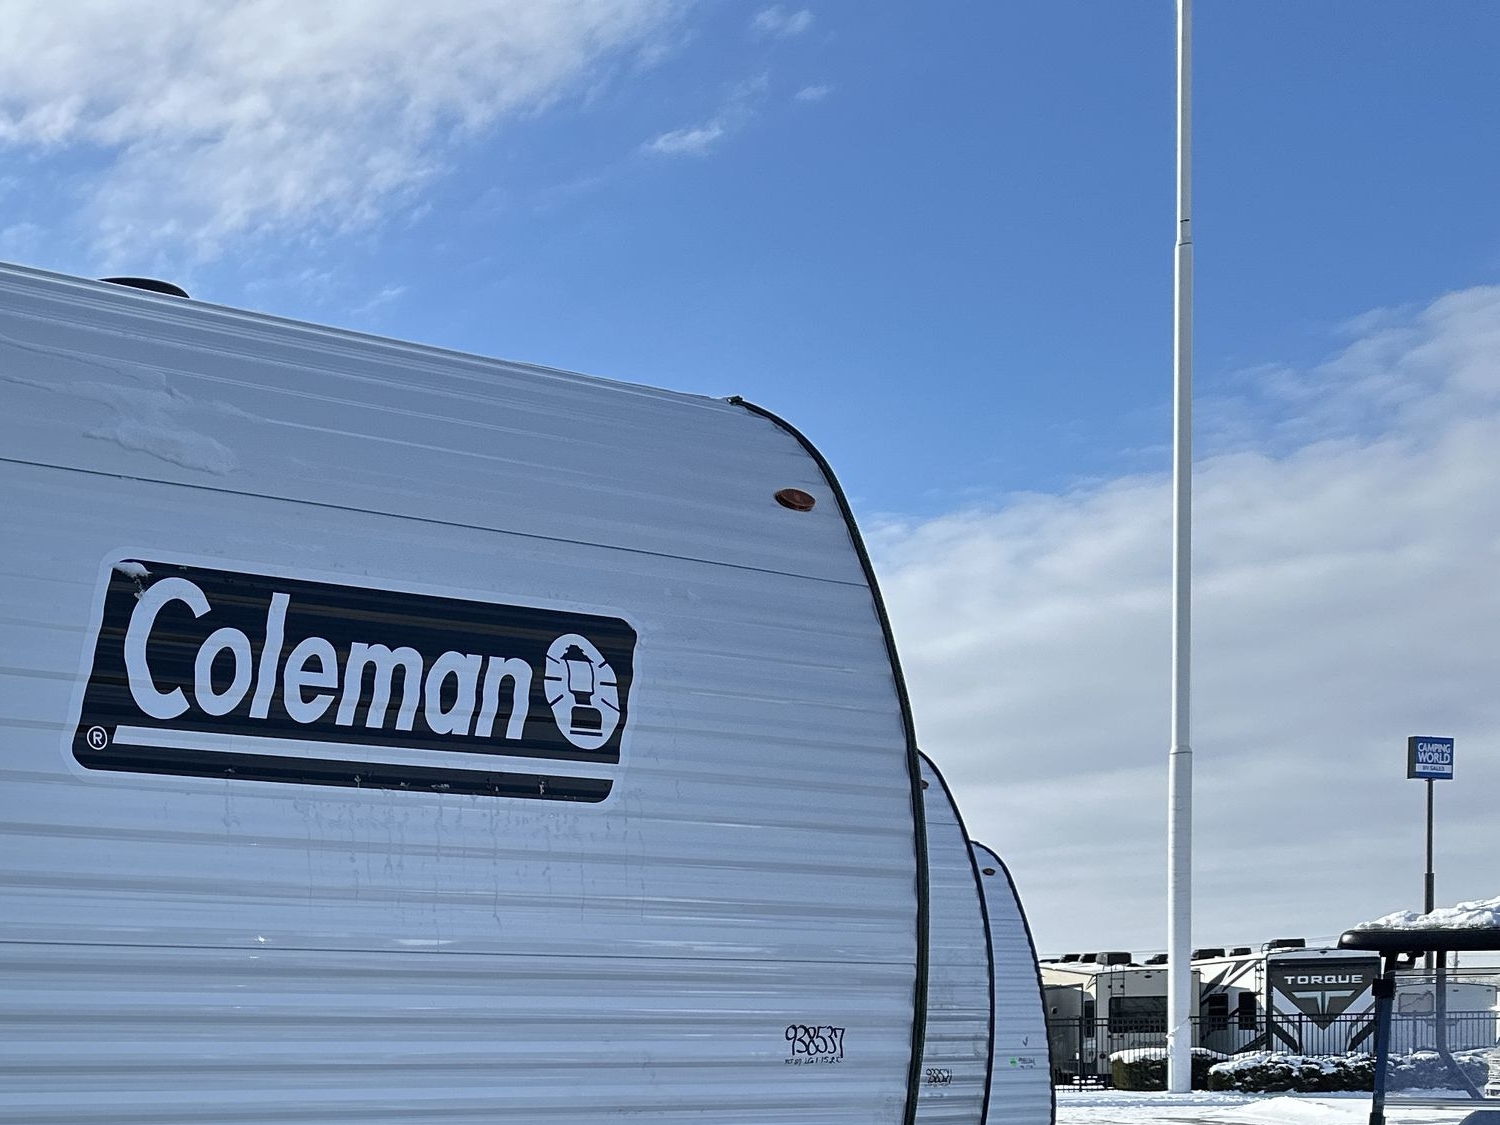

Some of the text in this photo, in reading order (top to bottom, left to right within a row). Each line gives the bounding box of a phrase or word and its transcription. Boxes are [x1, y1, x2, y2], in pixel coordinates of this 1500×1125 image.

[124, 576, 533, 741] Coleman
[1418, 742, 1451, 753] CAMPING
[1418, 751, 1451, 764] WORLD
[1283, 974, 1363, 985] TORQUE
[785, 1024, 846, 1059] 938537
